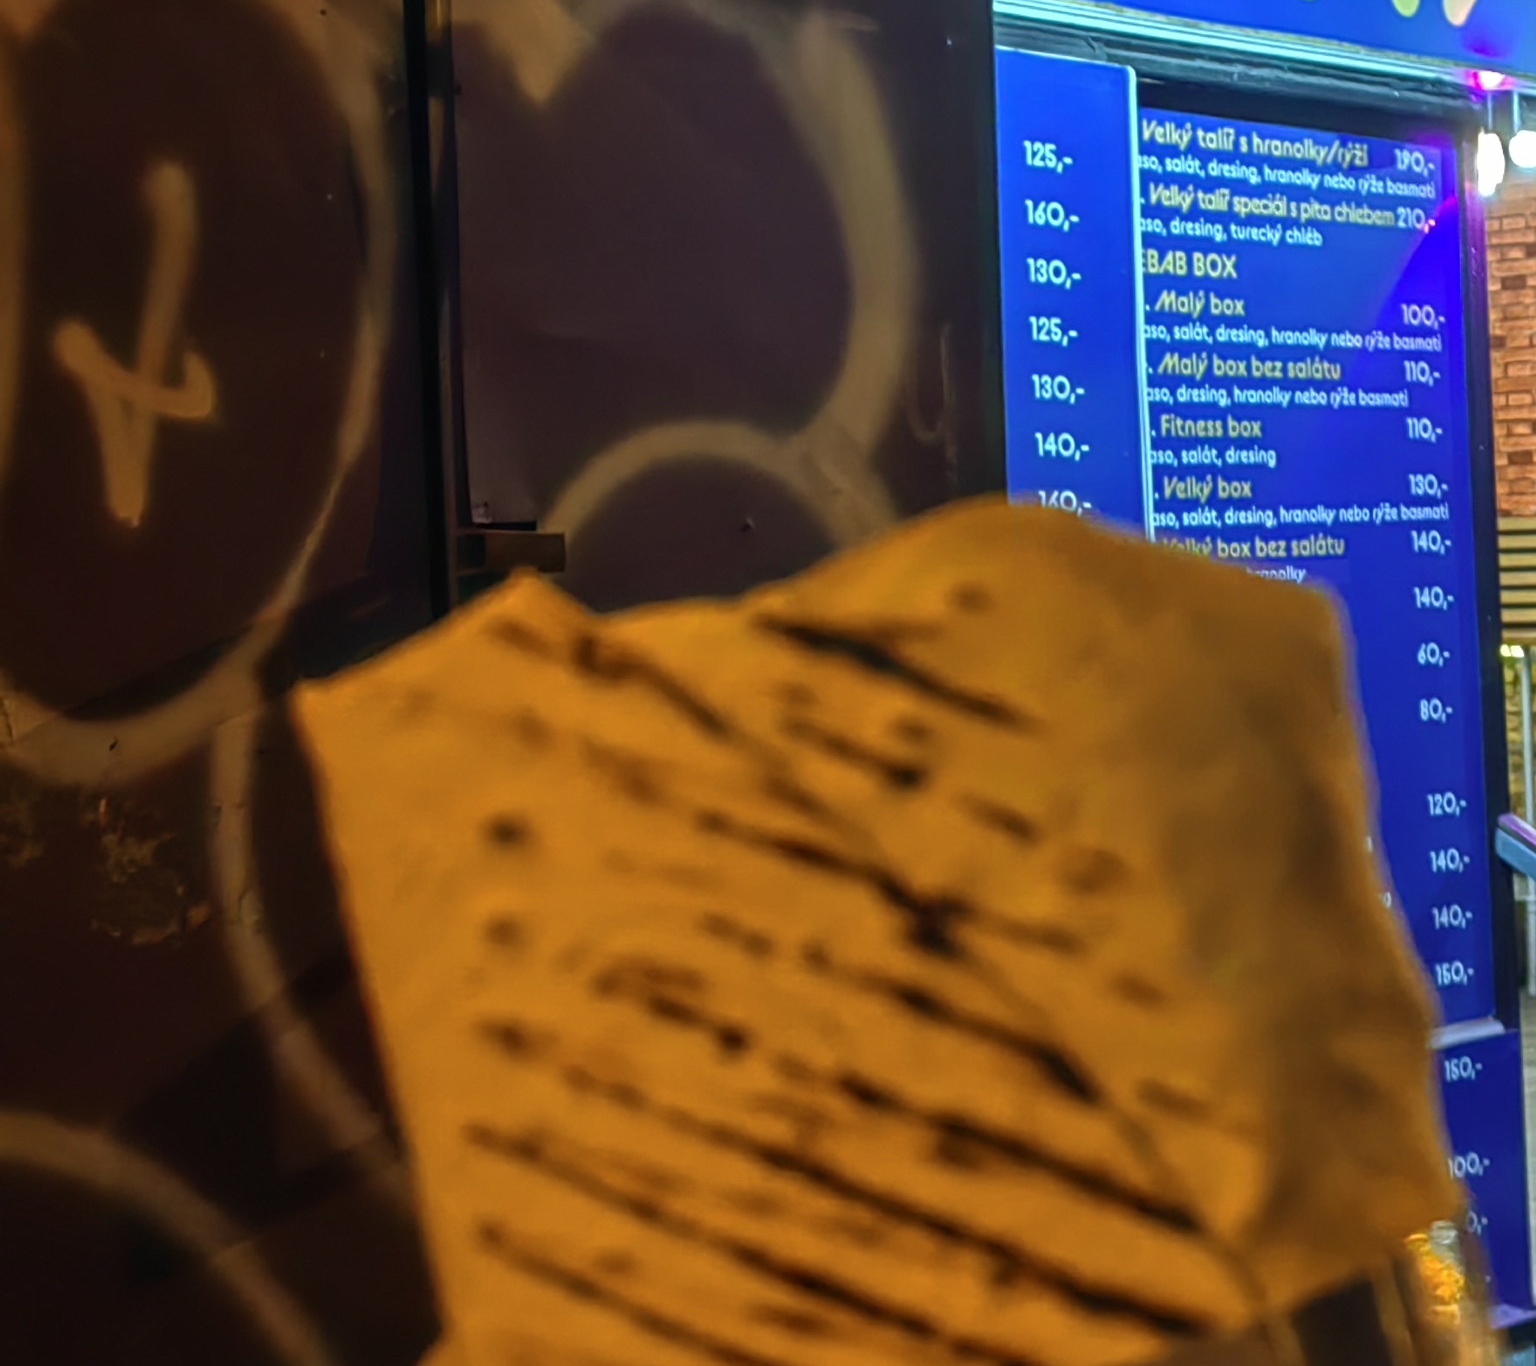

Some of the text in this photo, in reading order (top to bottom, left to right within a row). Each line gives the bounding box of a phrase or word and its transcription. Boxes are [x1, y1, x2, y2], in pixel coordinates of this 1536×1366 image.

[1142, 118, 1192, 151] Velký
[1239, 135, 1248, 153] s
[1023, 139, 1074, 174] 125,-
[1138, 154, 1162, 174] aso,
[1165, 153, 1205, 178] salát,
[1263, 163, 1321, 190] hranolky
[1324, 172, 1356, 191] nebo
[1386, 177, 1436, 199] basmati
[1025, 198, 1080, 233] 160,-
[1149, 181, 1194, 214] Velký
[1290, 202, 1298, 218] s
[1396, 206, 1436, 234] 210,-
[1140, 217, 1167, 237] aso,
[1170, 216, 1227, 242] dresing,
[1230, 222, 1282, 247] turecký
[1026, 257, 1082, 290] 130,-
[1193, 251, 1238, 279] BOX
[1154, 289, 1446, 330] Malý box 100,-
[1028, 315, 1079, 347] 125,-
[1144, 324, 1171, 344] aso,
[1173, 320, 1213, 344] salát,
[1215, 323, 1269, 348] dresing,
[1271, 325, 1328, 351] hranolky
[1331, 330, 1363, 349] nebo
[1393, 332, 1442, 353] basmati
[1157, 351, 1441, 387] Malý box bez salátu 110,-
[1031, 373, 1085, 405] 130,-
[1147, 386, 1174, 406] aso,
[1176, 383, 1231, 408] dresing,
[1233, 384, 1292, 408] hranolky
[1294, 386, 1328, 405] nebo
[1358, 387, 1409, 408] basmati
[1160, 413, 1443, 443] Fitness box 110,-
[1035, 432, 1090, 462] 140,-
[1150, 444, 1277, 468] aso, salát, dresing
[1163, 473, 1449, 504] Velký box 130,-
[1152, 511, 1179, 530] aso,
[1182, 505, 1221, 529] salát,
[1224, 505, 1277, 529] dresing,
[1279, 504, 1337, 527] hranolky
[1339, 504, 1370, 522] nebo
[1400, 502, 1449, 520] basmati
[1217, 537, 1251, 558] box
[1255, 535, 1287, 558] bez
[1291, 532, 1345, 557] salátu
[1411, 529, 1452, 555] 140,-
[1414, 586, 1454, 611] 140,-
[1417, 642, 1450, 667] 60,-
[1430, 847, 1470, 873] 140,-
